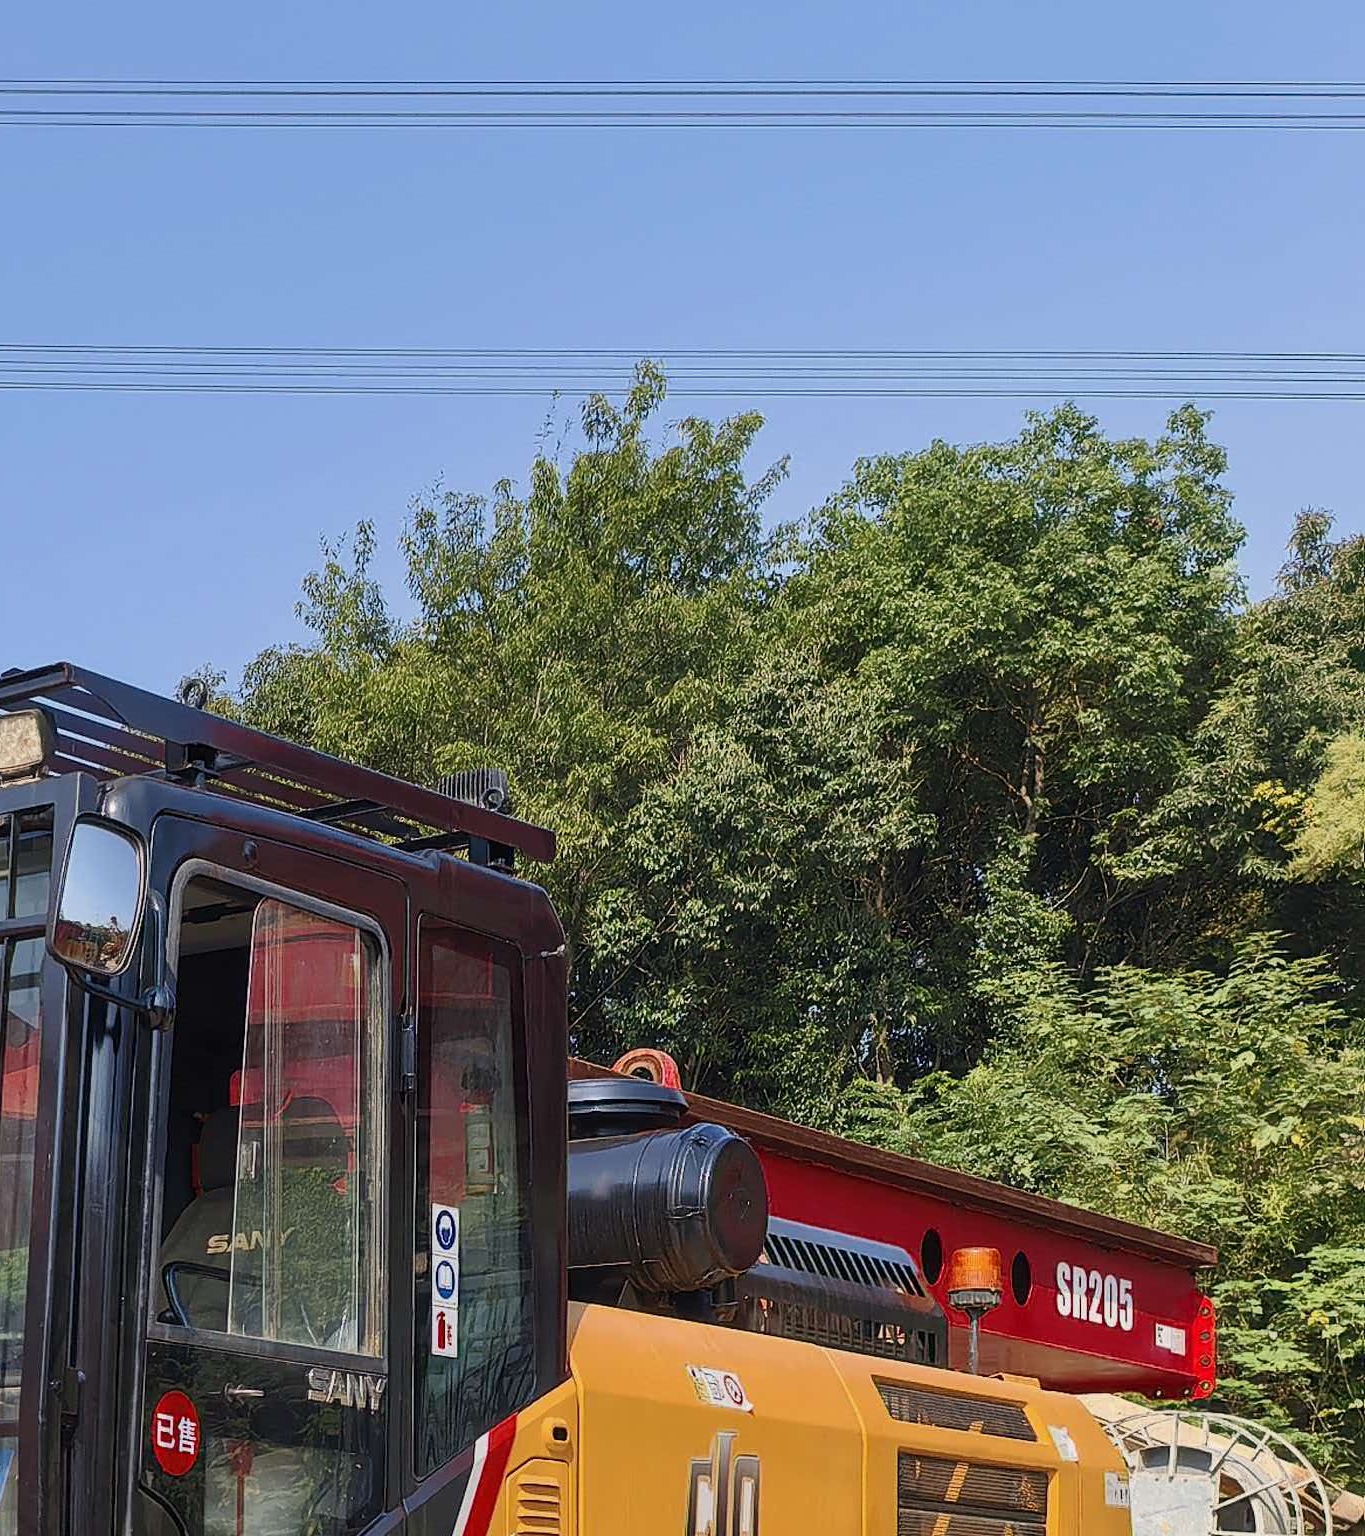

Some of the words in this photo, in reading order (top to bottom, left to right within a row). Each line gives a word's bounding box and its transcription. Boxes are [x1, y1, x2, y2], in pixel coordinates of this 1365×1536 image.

[206, 1227, 295, 1254] SANY
[1056, 1261, 1133, 1332] SR205
[307, 1367, 388, 1411] SANY
[156, 1412, 197, 1455] 已售
